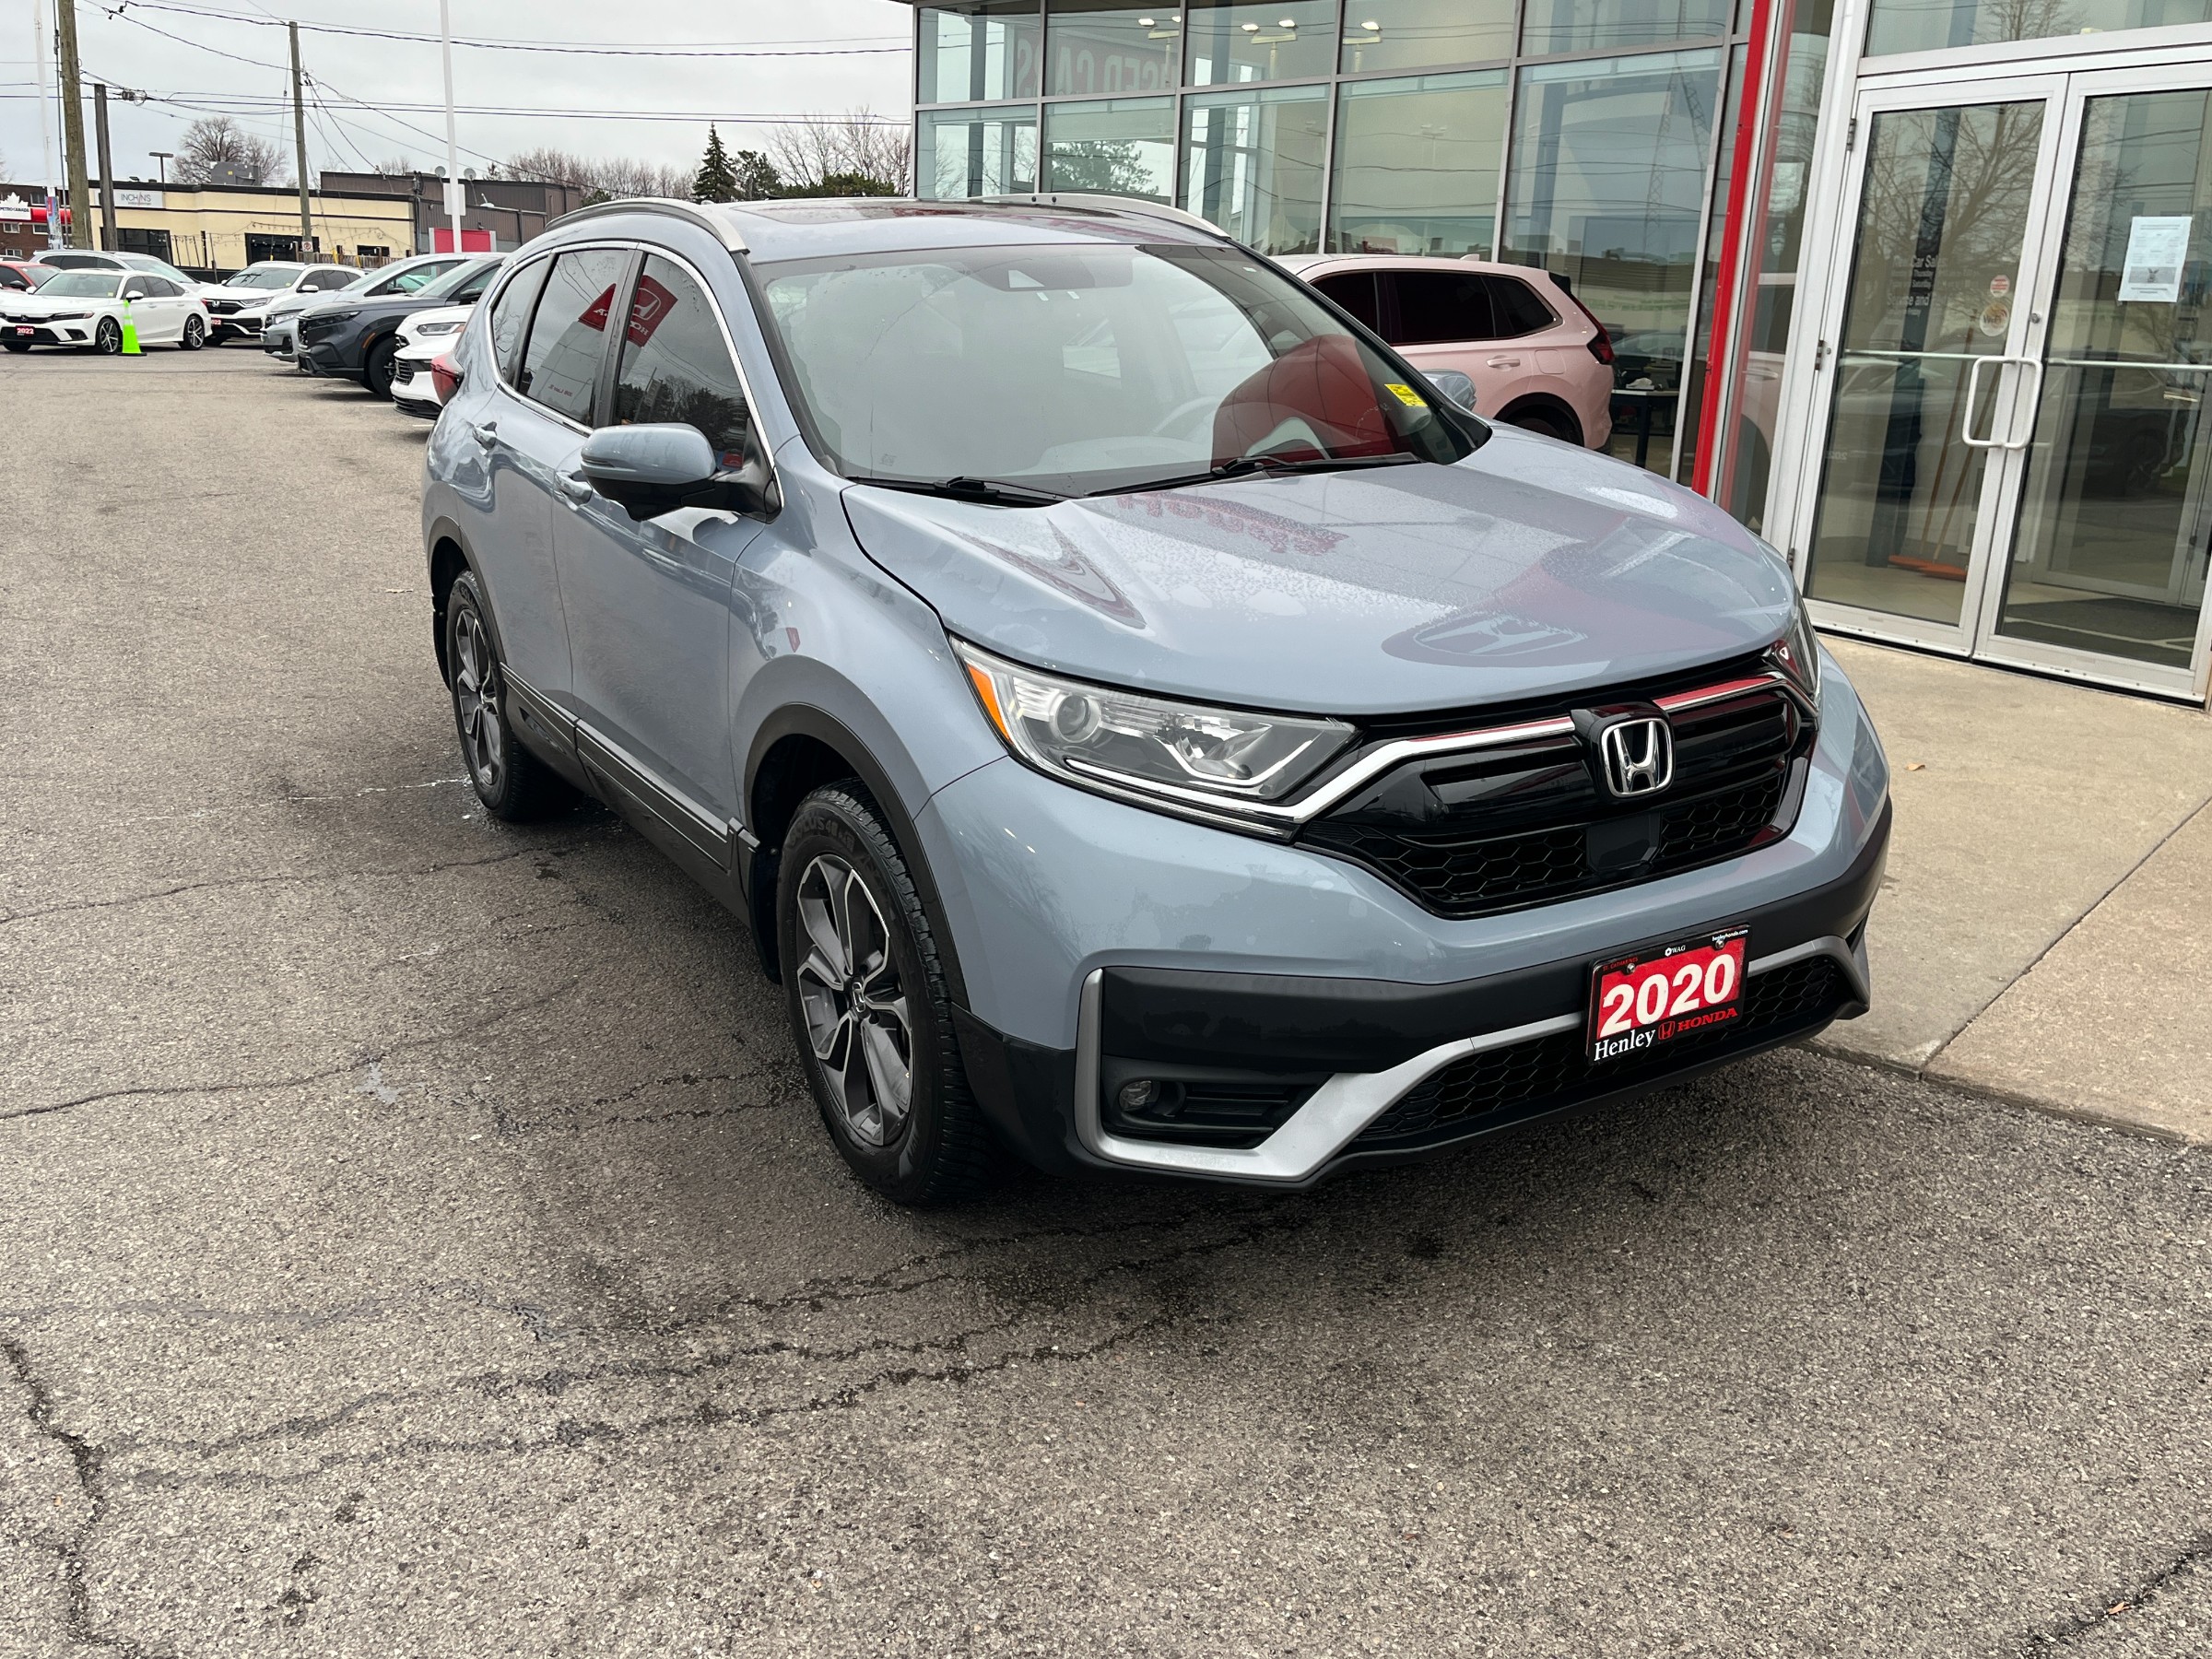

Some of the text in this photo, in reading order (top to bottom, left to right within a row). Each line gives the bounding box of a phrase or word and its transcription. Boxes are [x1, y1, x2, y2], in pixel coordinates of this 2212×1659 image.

[1599, 953, 1736, 1039] 2020
[1594, 1029, 1656, 1061] Henley
[1677, 1006, 1738, 1032] HONDA
